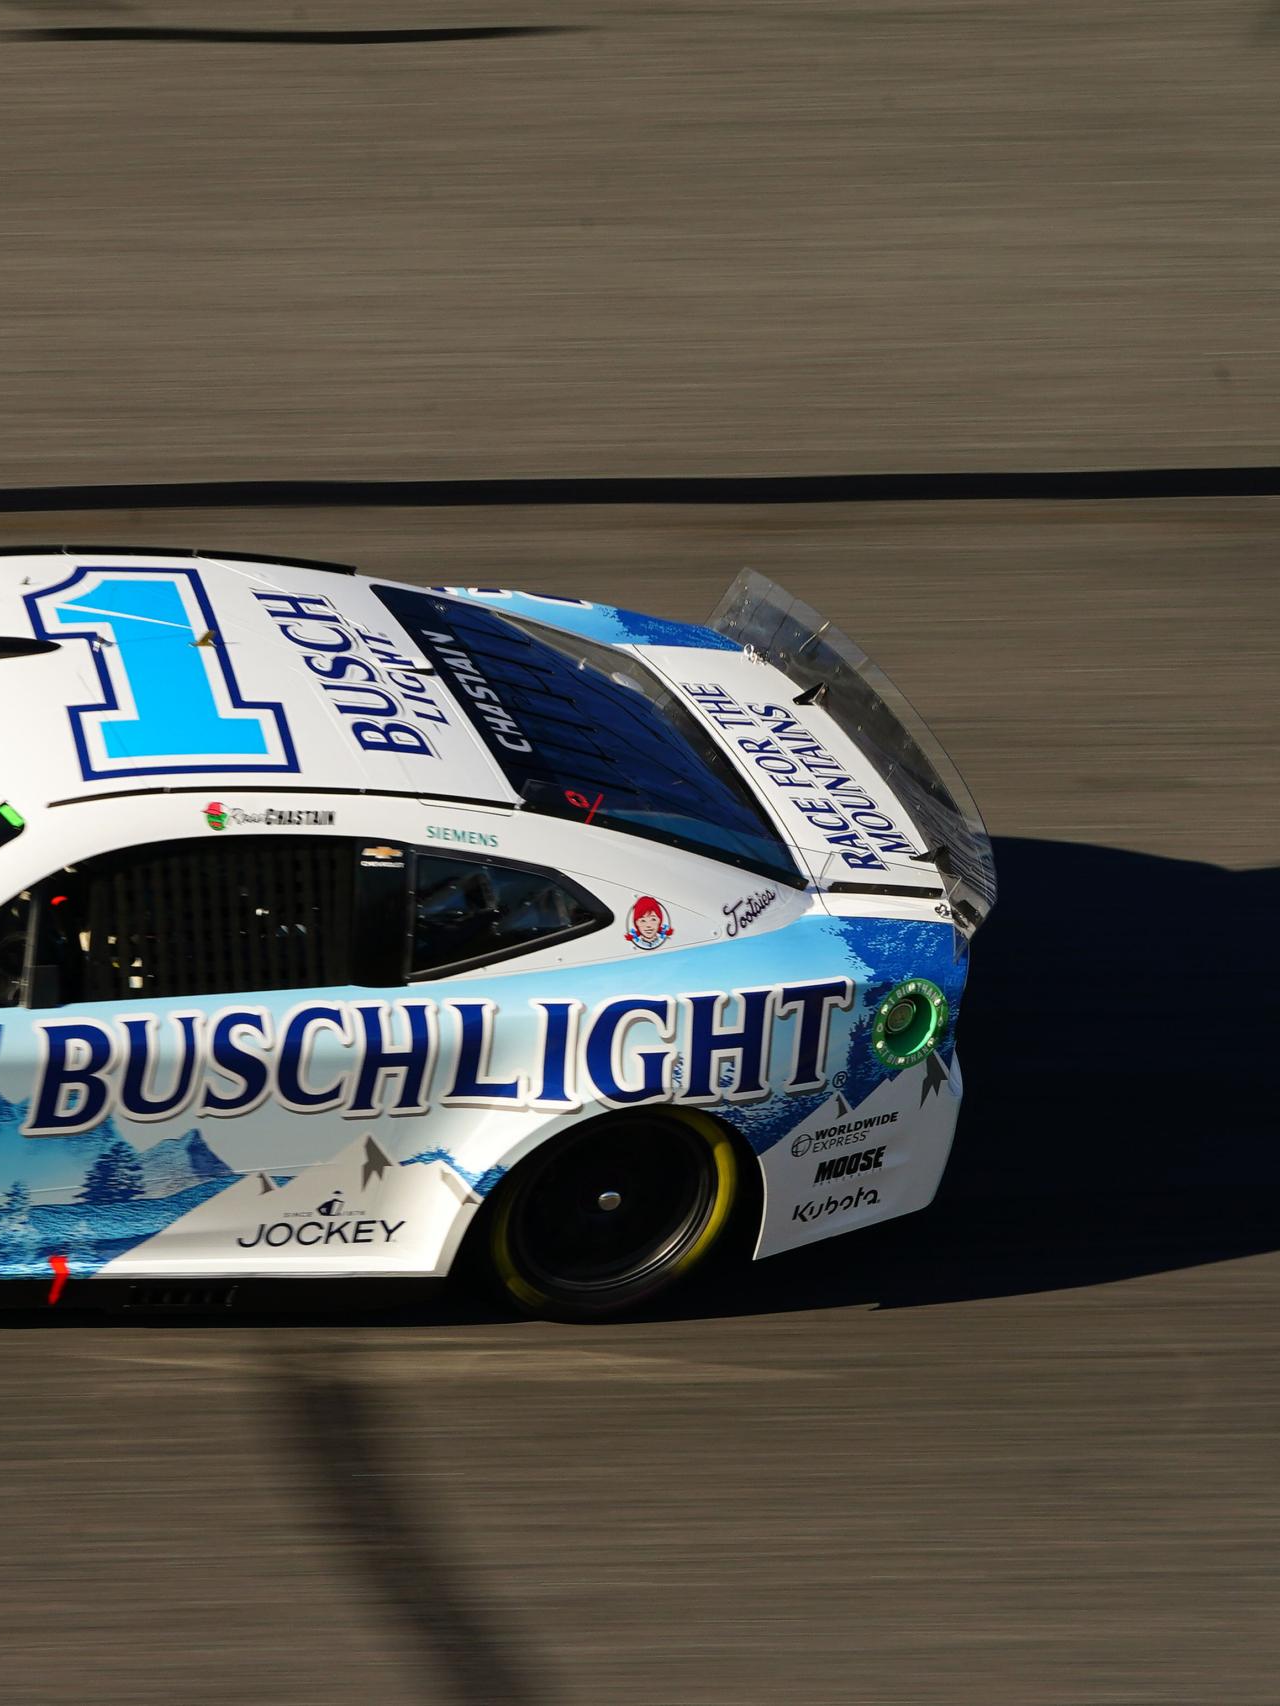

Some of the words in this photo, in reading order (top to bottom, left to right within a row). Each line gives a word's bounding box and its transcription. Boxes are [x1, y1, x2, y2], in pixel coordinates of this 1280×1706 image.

[23, 566, 300, 781] 1
[251, 589, 438, 758] BUSCH
[354, 627, 450, 727] LIGHT
[421, 629, 533, 753] CHASTAIN
[683, 684, 759, 730] THE
[738, 736, 818, 790] FOR
[748, 702, 920, 860] MOUNTAINS
[265, 808, 336, 826] CHASTAIN
[426, 825, 499, 848] SIEMENS
[793, 797, 890, 871] RACE
[722, 889, 776, 937] Tootsies
[812, 1130, 869, 1154] EXPRESS
[815, 1111, 900, 1141] WORLDWIDE
[814, 1145, 887, 1184] MOOSE
[791, 1187, 879, 1223] Kubota
[236, 1219, 407, 1249] JOCKEY
